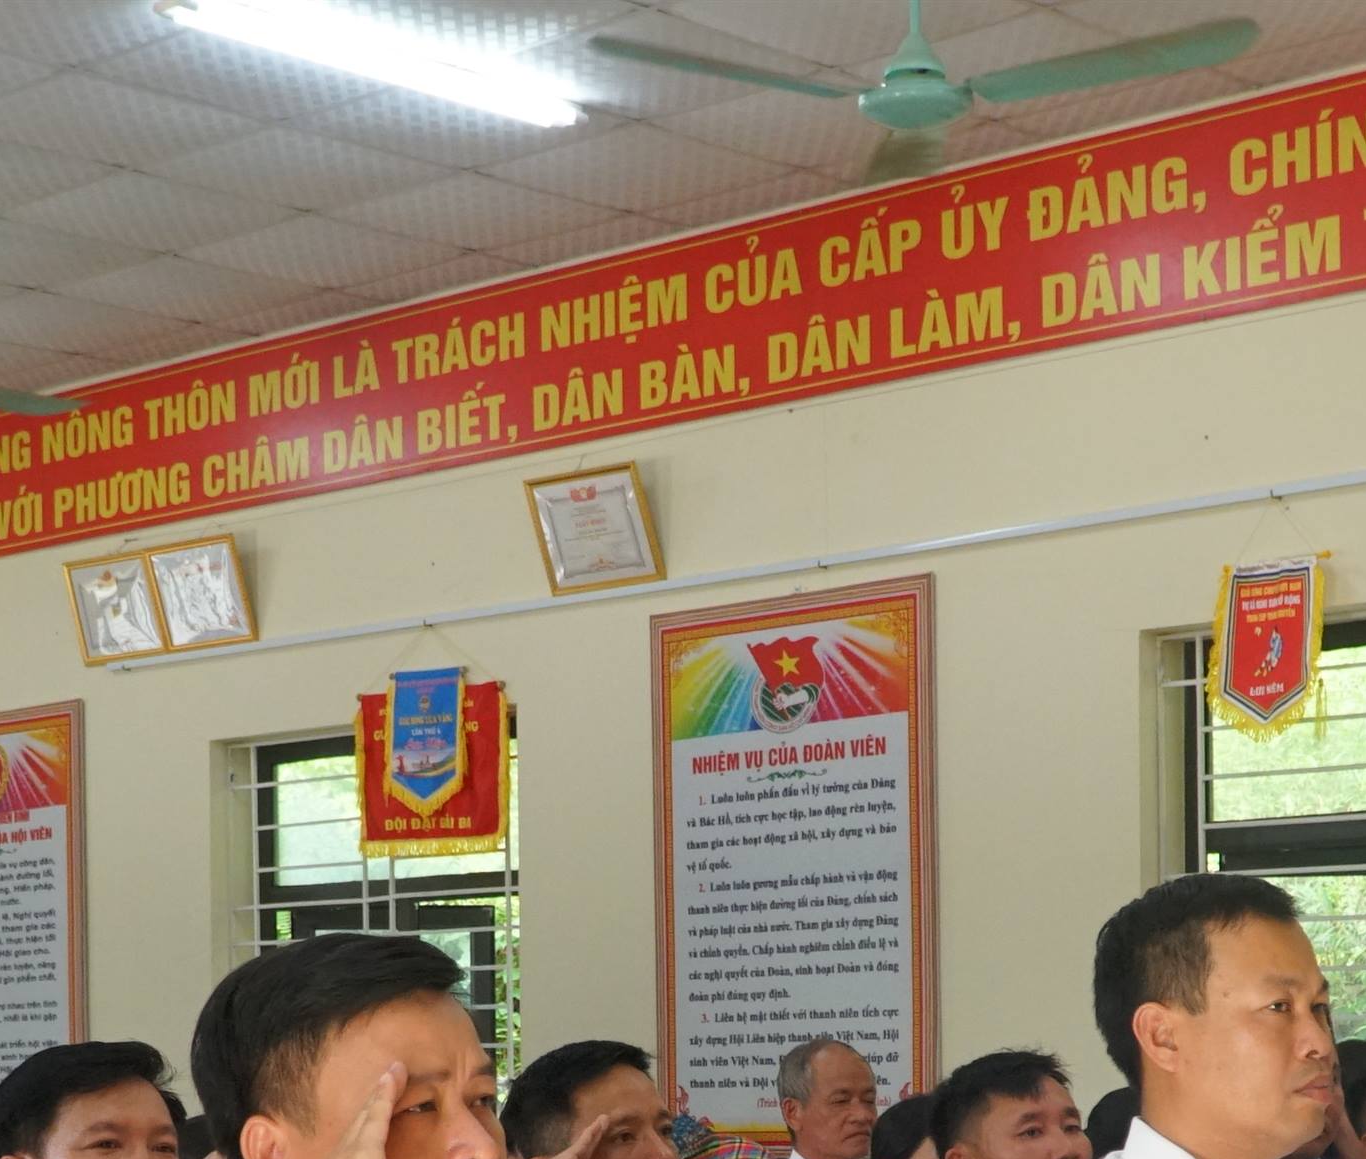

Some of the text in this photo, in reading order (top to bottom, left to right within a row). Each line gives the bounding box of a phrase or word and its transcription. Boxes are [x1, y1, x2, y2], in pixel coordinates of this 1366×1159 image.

[41, 407, 134, 464] NÔNG
[144, 380, 235, 440] THÔN
[249, 353, 320, 417] MỚI
[333, 340, 380, 399] LÀ
[392, 312, 525, 384] TRÁCH
[540, 272, 688, 353] NHIỆM
[704, 235, 802, 314] CỦA
[819, 207, 922, 287] CẤP
[941, 184, 1009, 259] ỦY
[1027, 153, 1207, 241] ĐẢNG,
[54, 462, 190, 528] PHƯƠNG
[202, 436, 309, 497] CHÂM
[323, 414, 403, 475] DÂN
[417, 381, 518, 455] BIẾT,
[533, 367, 623, 432] DÂN
[639, 343, 750, 410] BÀN,
[768, 314, 871, 385] DÂN
[890, 286, 1022, 360] LÀM,
[1041, 252, 1161, 328] DÂN
[1183, 204, 1341, 300] KIỂM
[30, 826, 52, 840] VIÊN
[692, 733, 885, 775] NHIỆM VỤ CỦA ĐOÀN VIÊN
